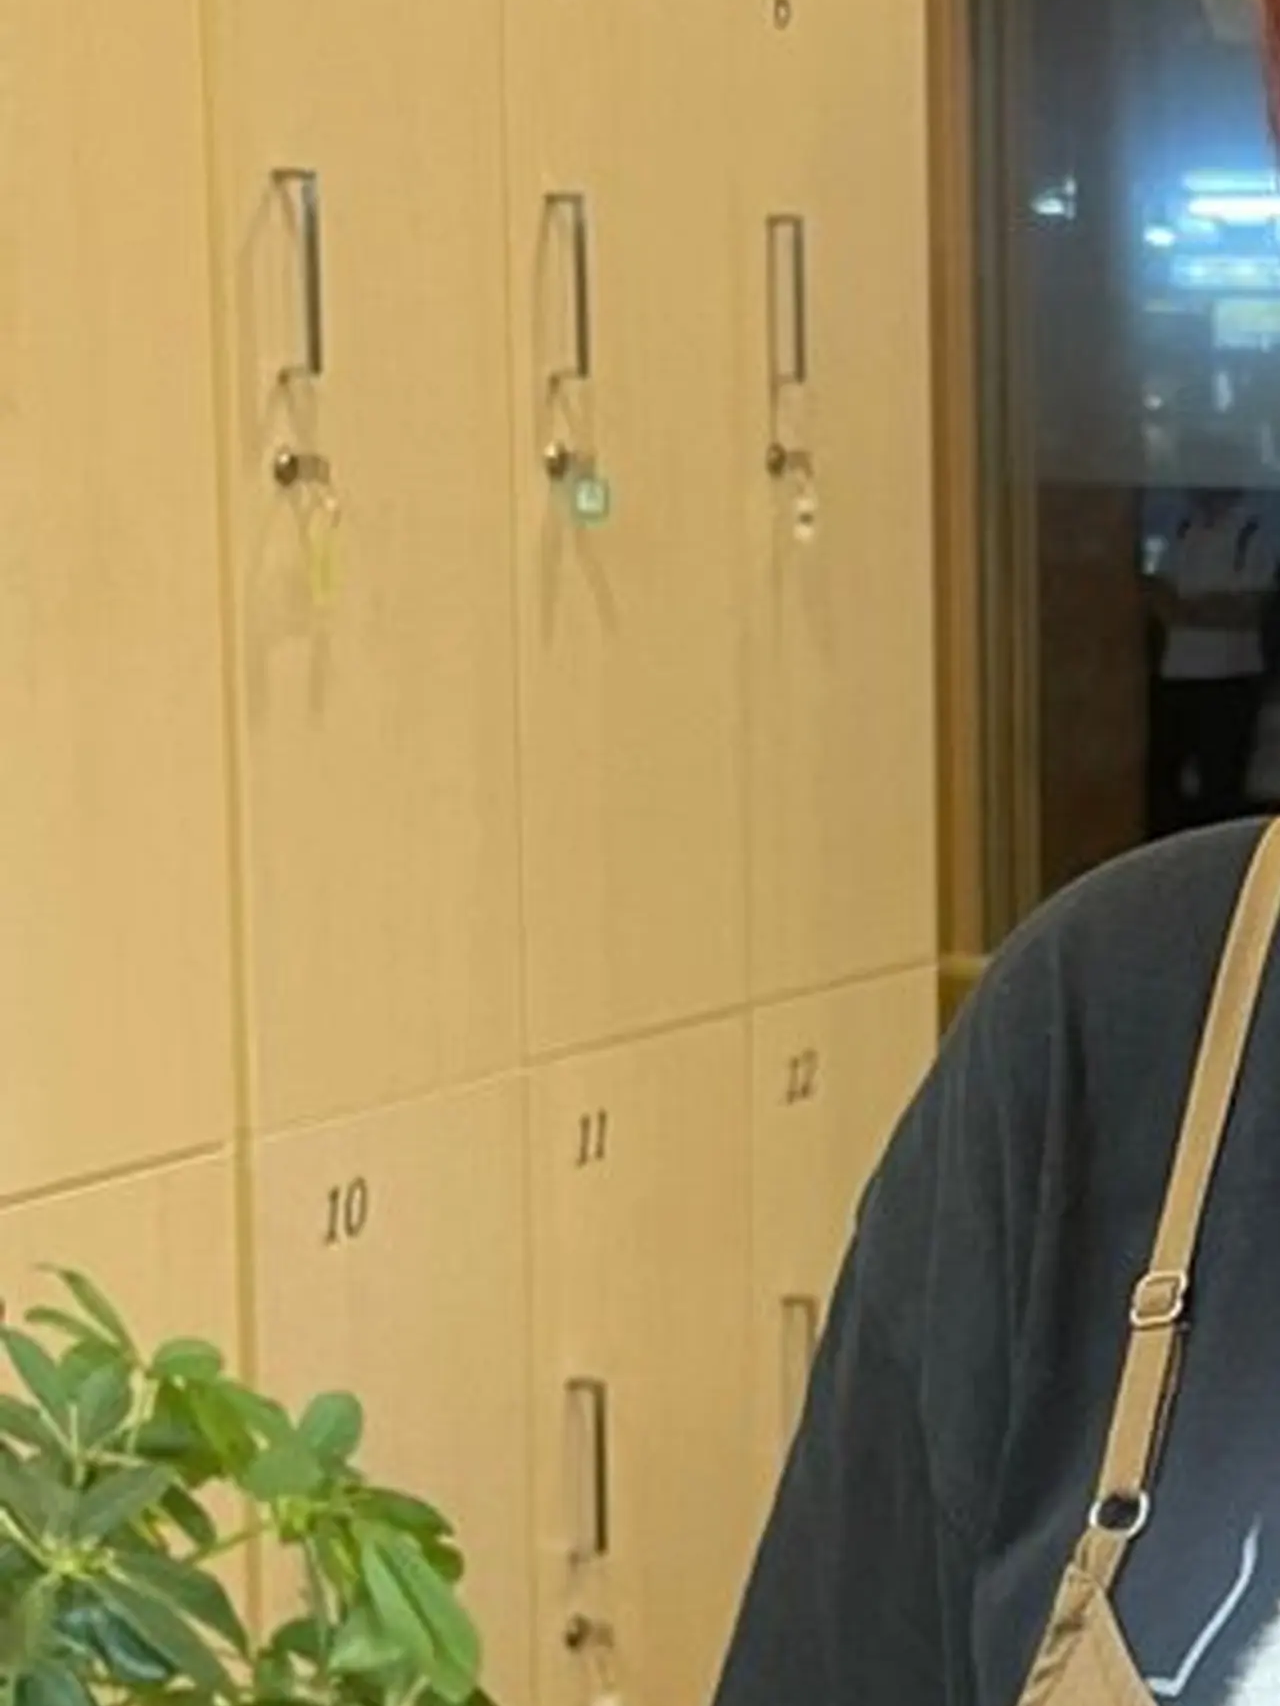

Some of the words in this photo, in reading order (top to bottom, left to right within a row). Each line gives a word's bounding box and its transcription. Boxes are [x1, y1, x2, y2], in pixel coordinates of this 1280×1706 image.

[786, 1049, 817, 1104] 12
[575, 1108, 608, 1168] 11
[322, 1175, 368, 1246] 10
